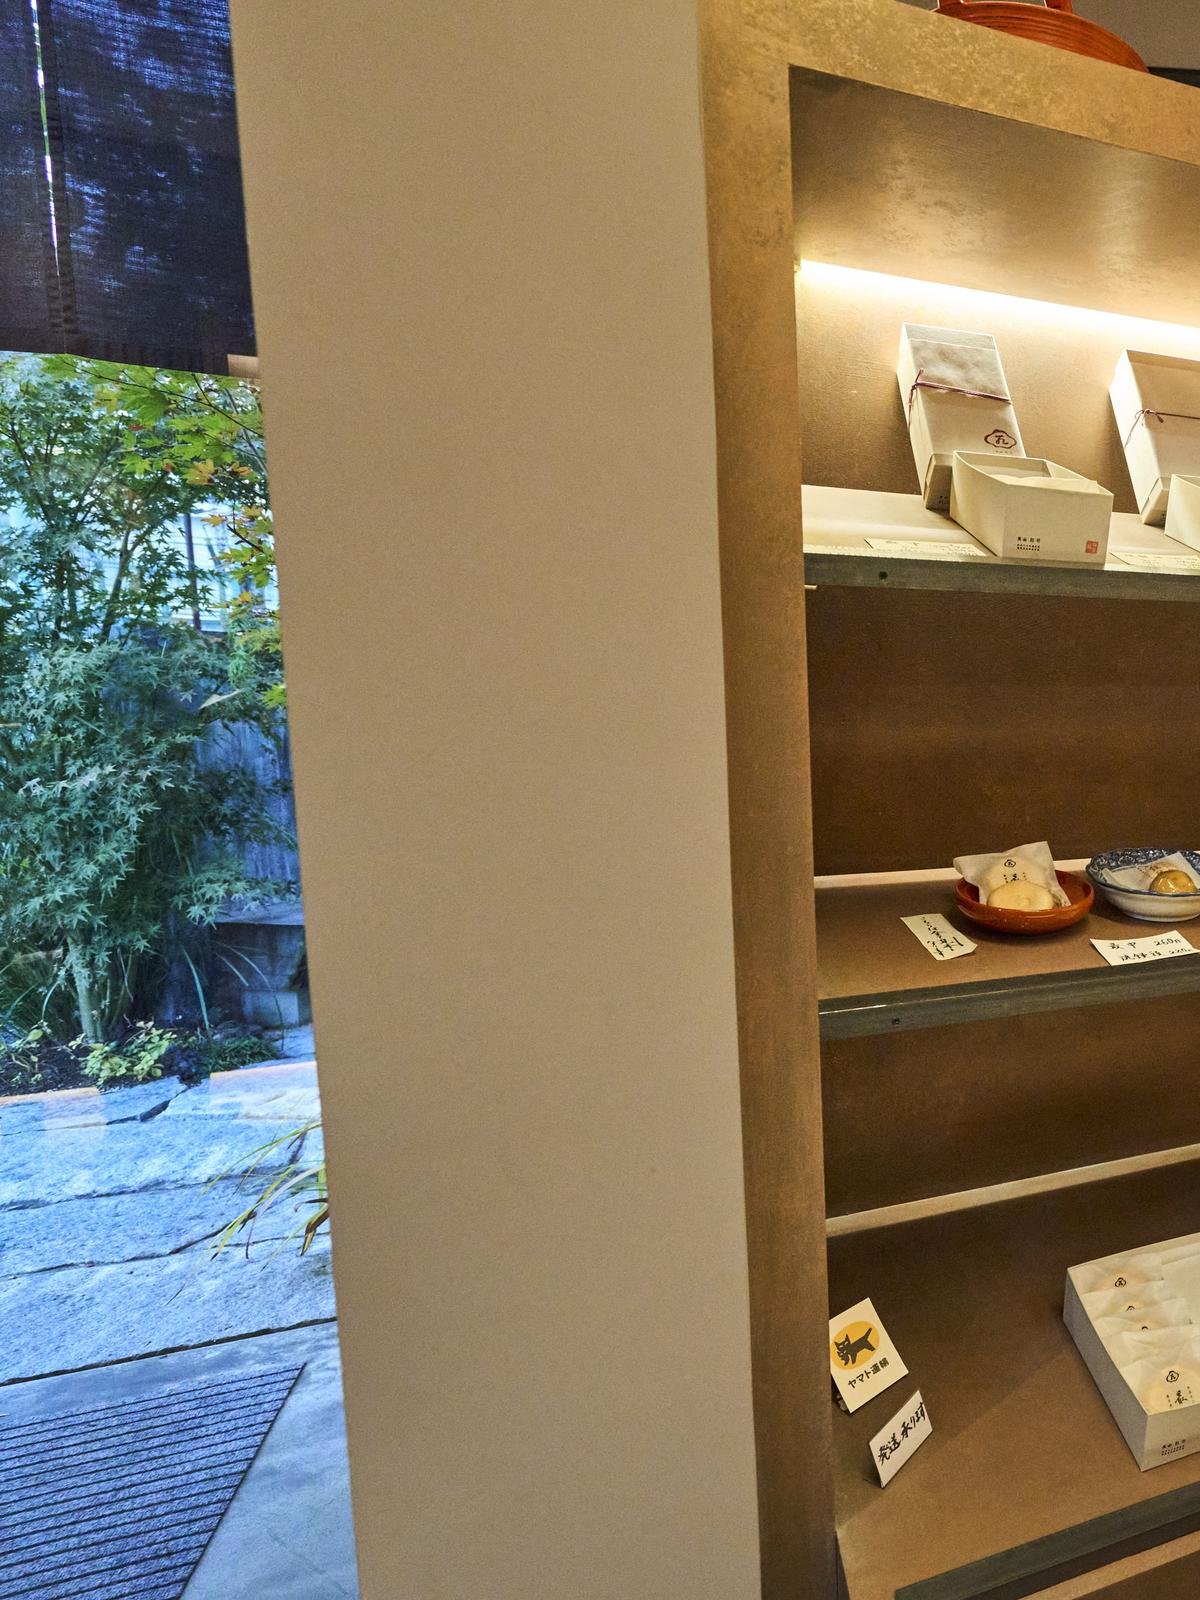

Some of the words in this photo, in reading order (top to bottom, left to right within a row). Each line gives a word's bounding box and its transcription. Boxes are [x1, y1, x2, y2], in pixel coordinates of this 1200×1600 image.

[848, 1357, 890, 1389] ヤマト運輸
